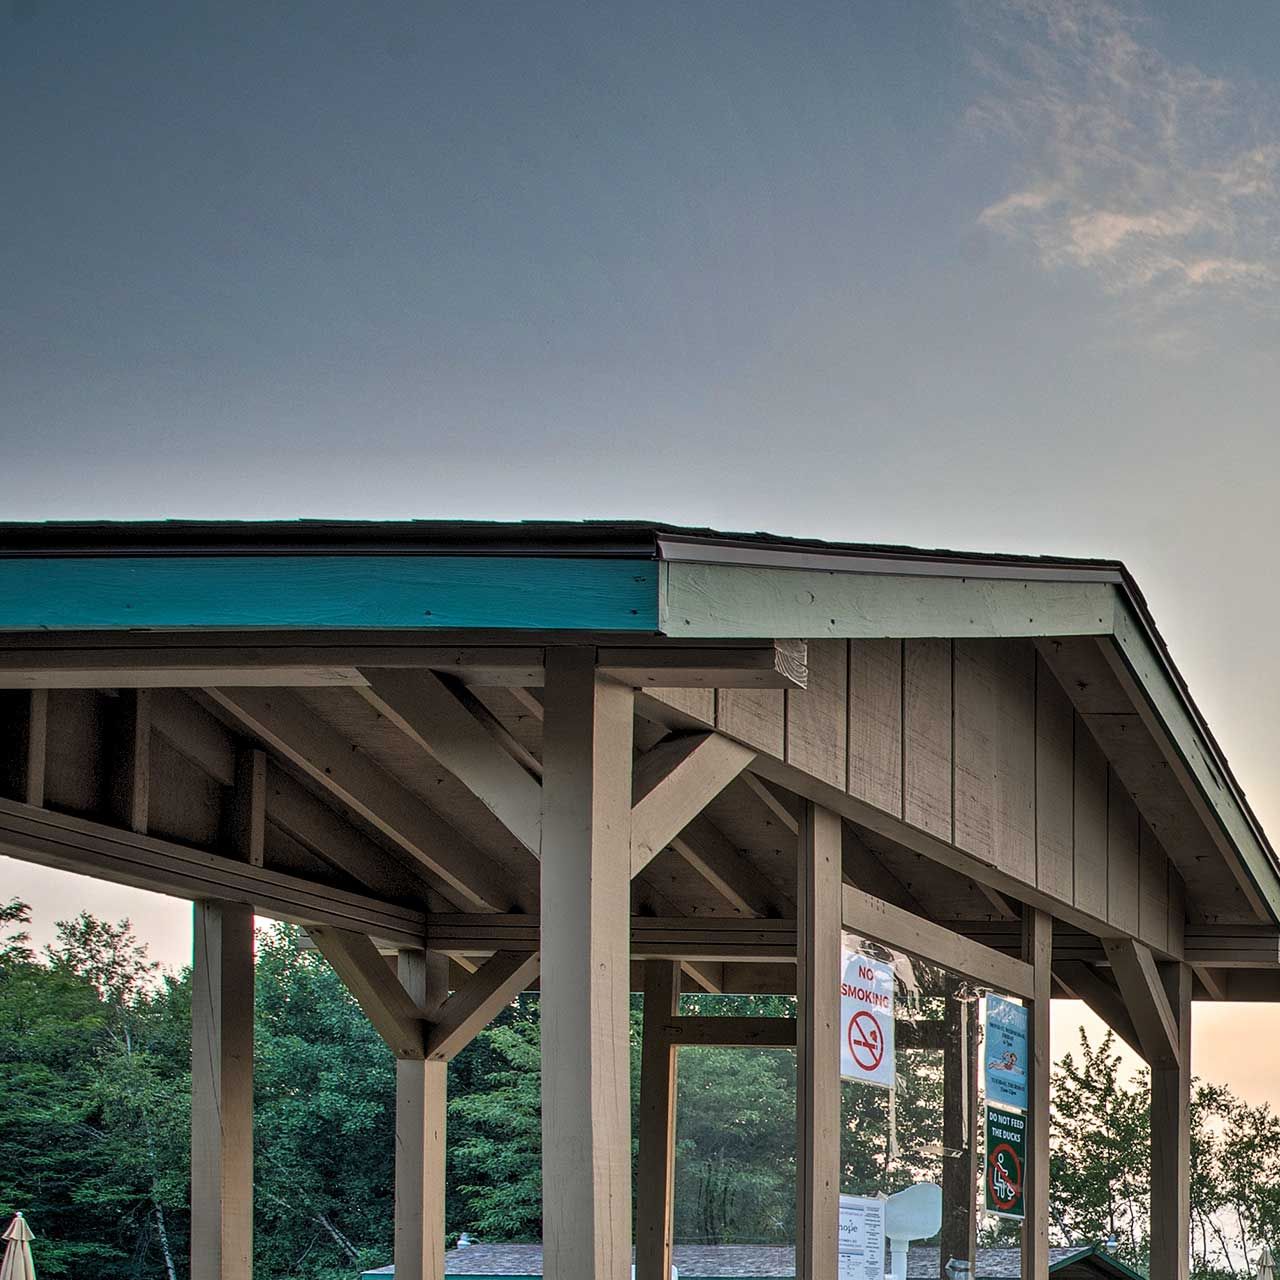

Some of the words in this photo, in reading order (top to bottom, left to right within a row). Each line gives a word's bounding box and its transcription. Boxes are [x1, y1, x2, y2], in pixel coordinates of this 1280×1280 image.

[858, 965, 874, 981] NO
[841, 983, 889, 1008] SMOKING
[989, 1112, 998, 1122] DO
[998, 1115, 1010, 1126] NOT
[1010, 1118, 1024, 1129] FEED
[991, 1127, 1002, 1138] THE
[1002, 1130, 1021, 1143] DUCKS
